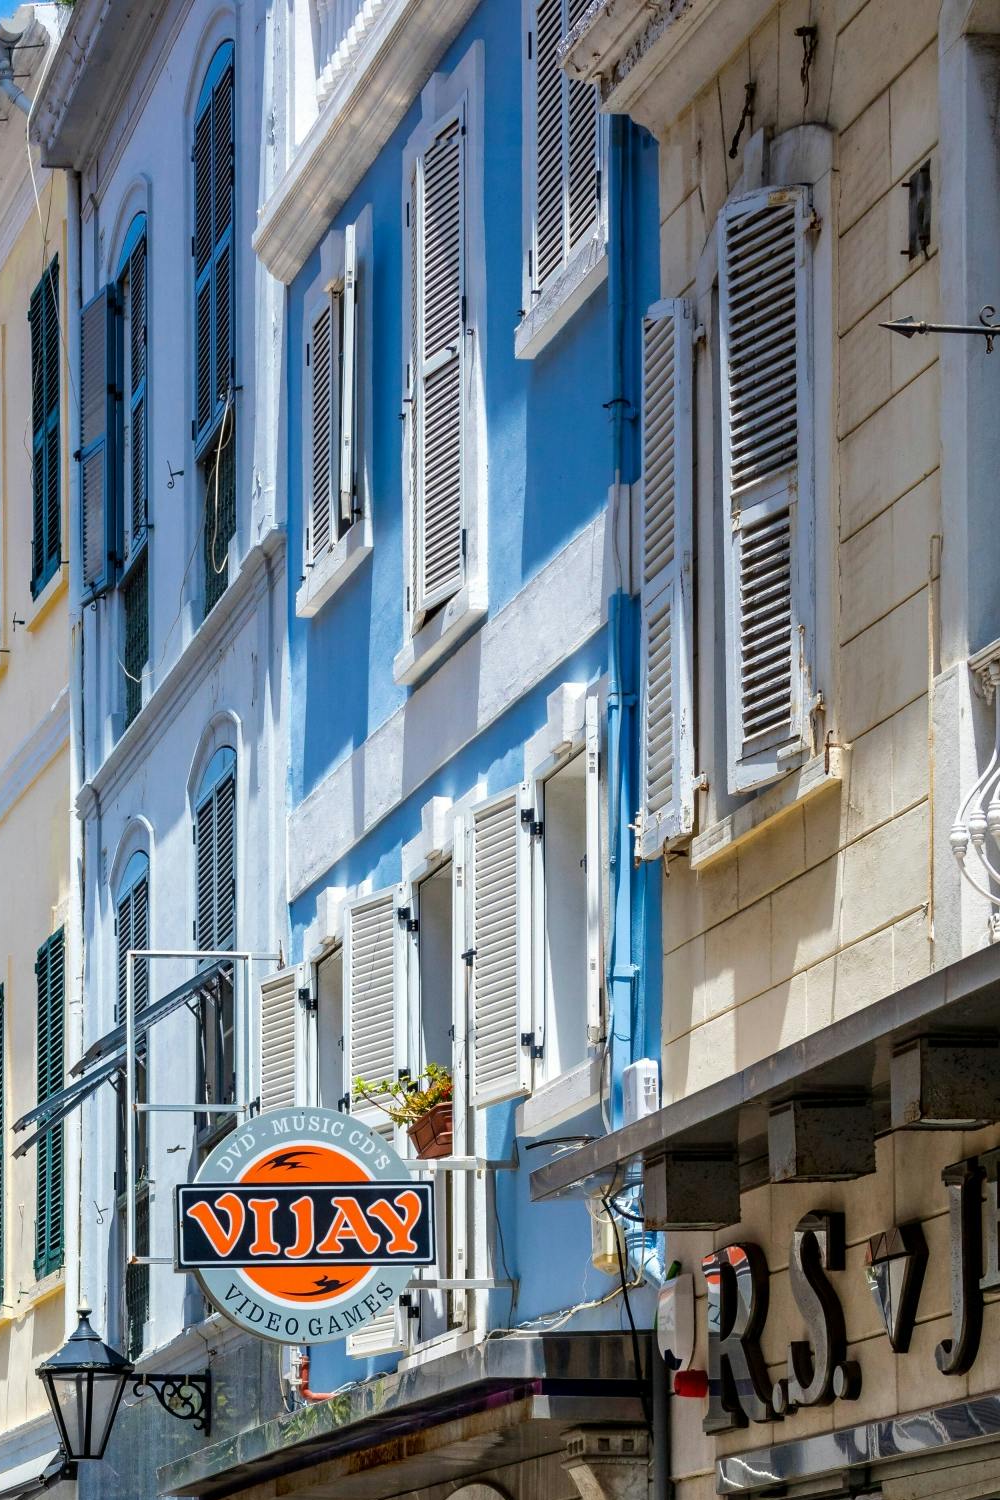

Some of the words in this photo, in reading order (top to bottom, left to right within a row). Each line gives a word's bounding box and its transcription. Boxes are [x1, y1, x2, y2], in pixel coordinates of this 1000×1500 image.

[215, 1128, 256, 1173] DVD
[272, 1115, 345, 1138] MUSIC
[351, 1130, 391, 1170] CD'S
[187, 1190, 422, 1258] VIJAY
[224, 1282, 299, 1335] VIDEO
[308, 1281, 394, 1337] GAMES
